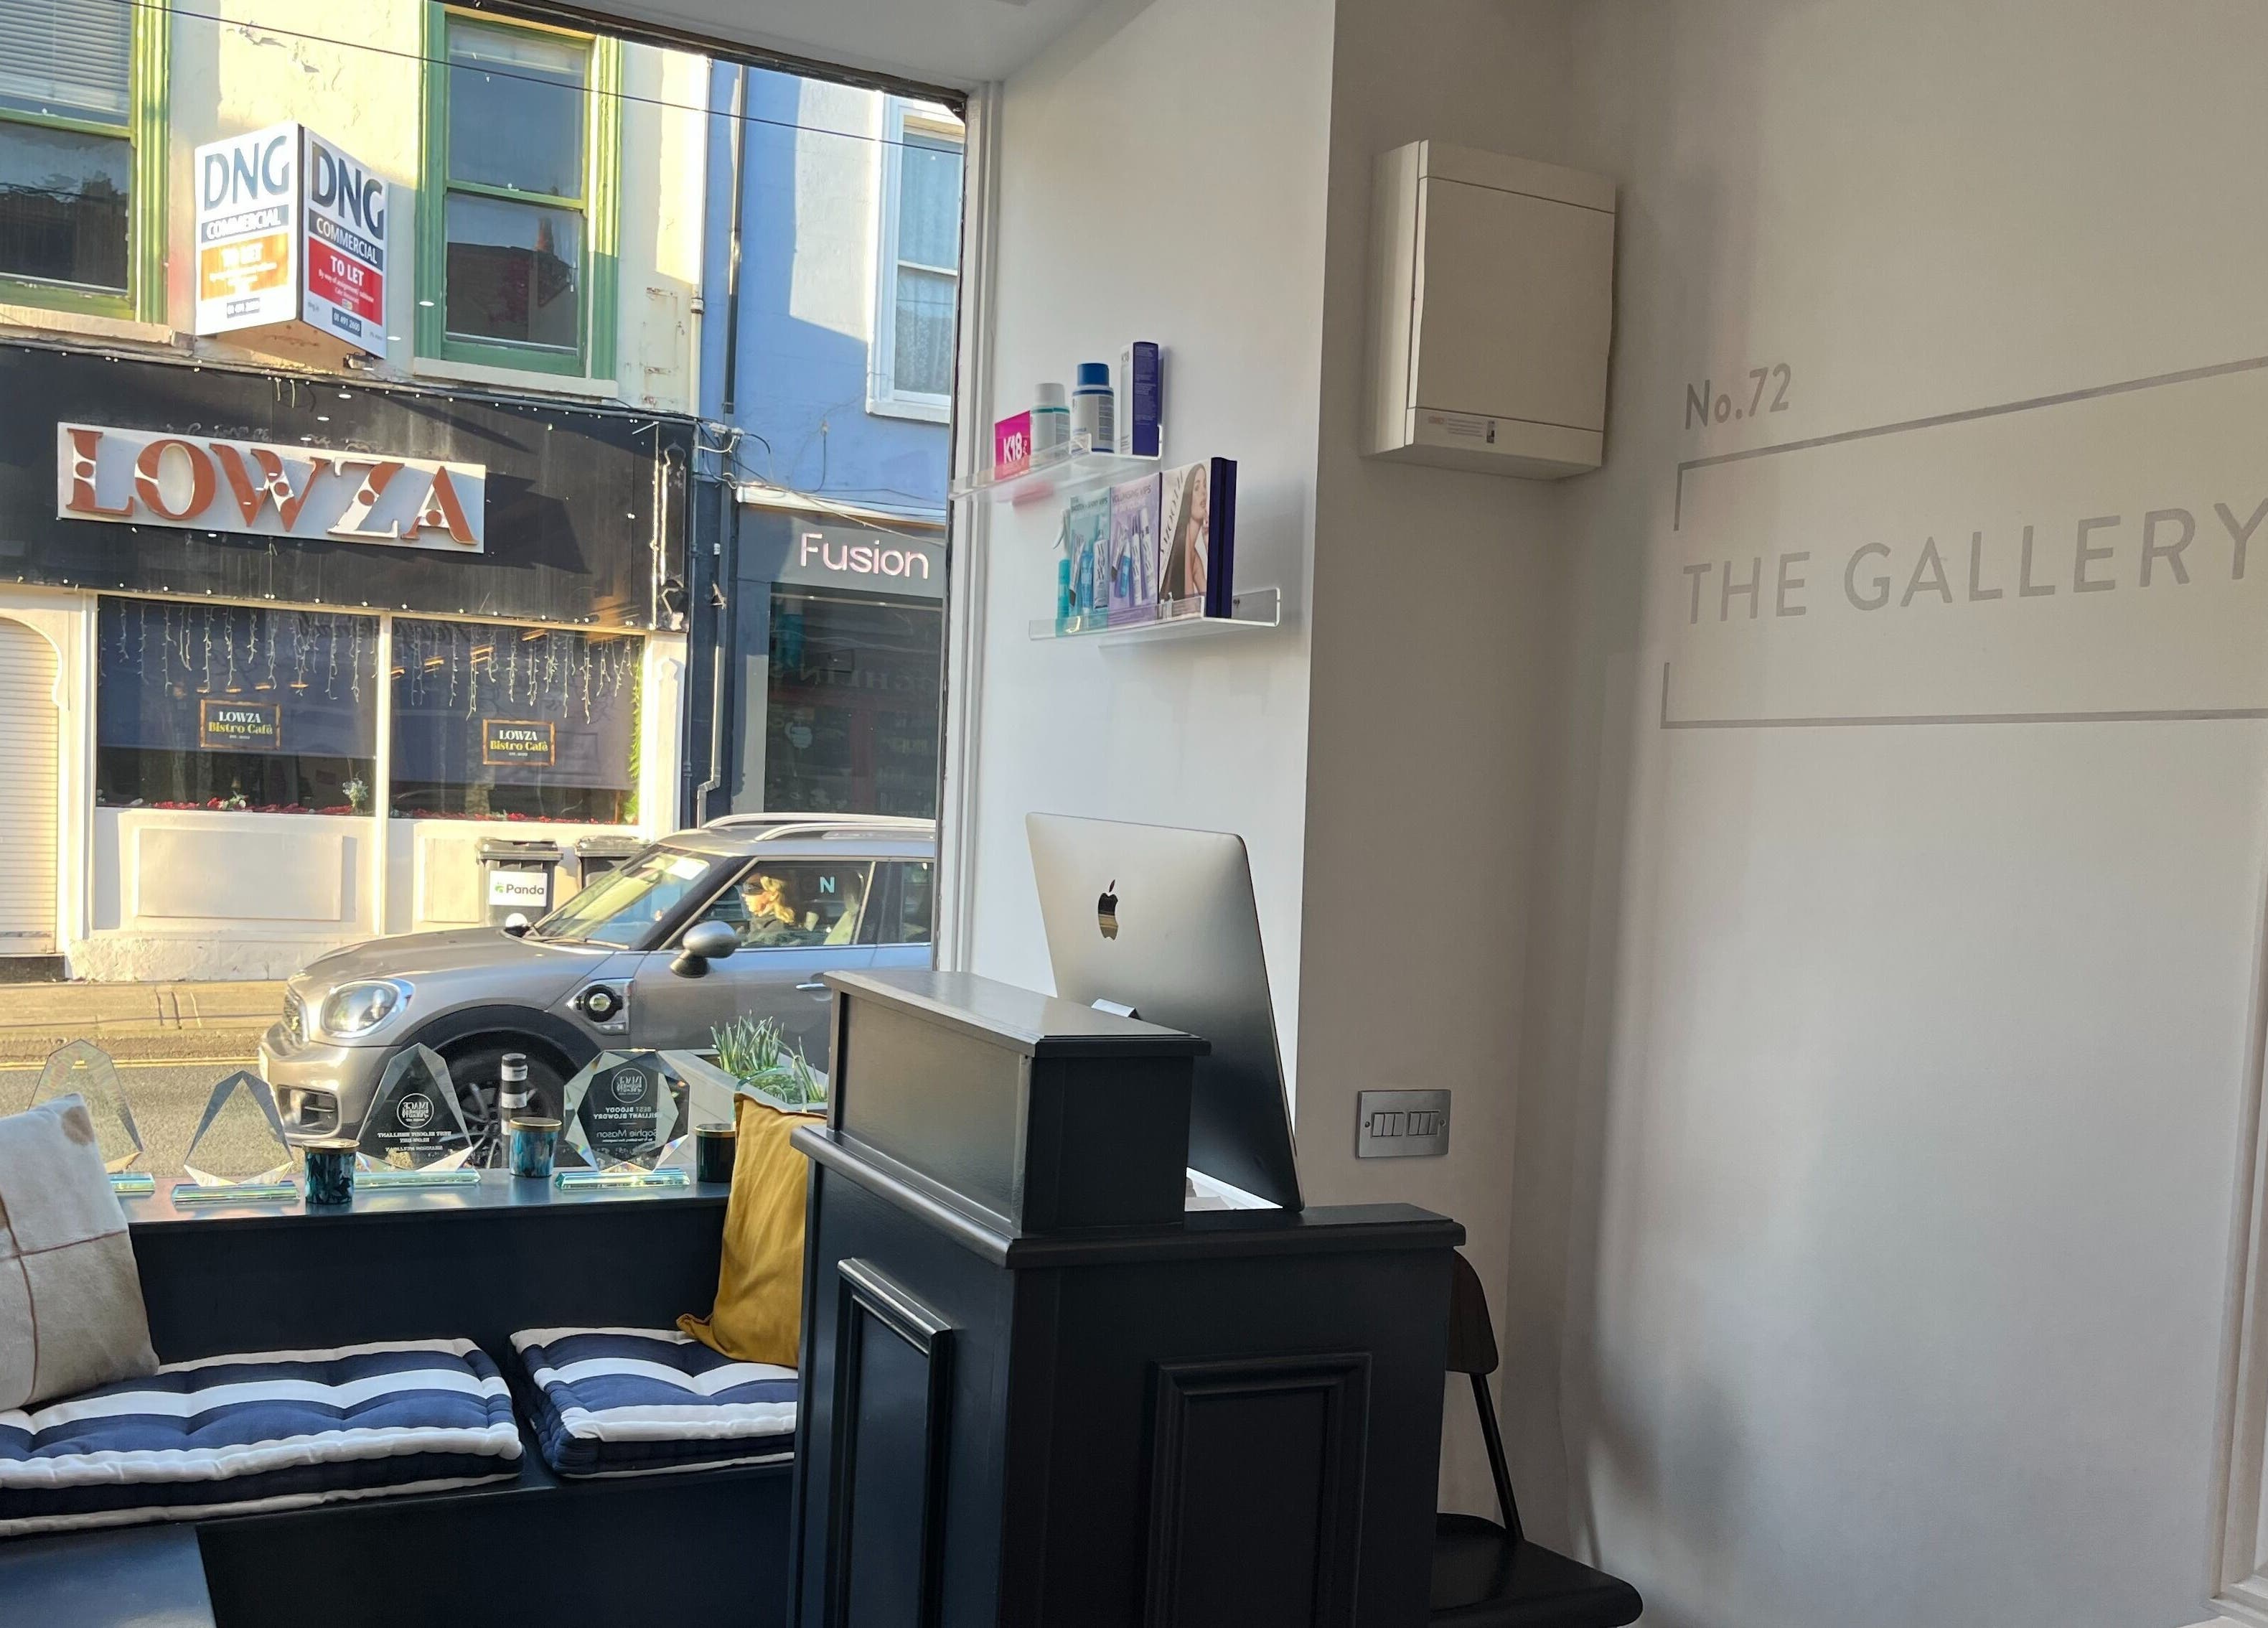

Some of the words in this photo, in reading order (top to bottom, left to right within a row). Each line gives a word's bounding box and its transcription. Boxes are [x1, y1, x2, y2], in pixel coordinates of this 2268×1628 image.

[205, 135, 289, 211] DNG
[311, 141, 383, 240] DNG
[207, 207, 281, 240] COMMERCIAL
[316, 217, 378, 264] COMMERCIAL
[330, 256, 345, 277] TO
[347, 264, 365, 286] LET
[1685, 362, 1791, 430] No.72
[1003, 431, 1022, 464] K18
[66, 428, 478, 545] LOWZA
[800, 533, 929, 579] Fusion
[1683, 551, 1810, 624] THE
[1844, 497, 2268, 611] GALLERY
[208, 721, 245, 734] Bistro
[218, 711, 261, 724] LOWZA
[490, 740, 523, 752] Bistro
[499, 729, 538, 741] LOWZA
[505, 884, 545, 896] Panda
[820, 876, 835, 893] N
